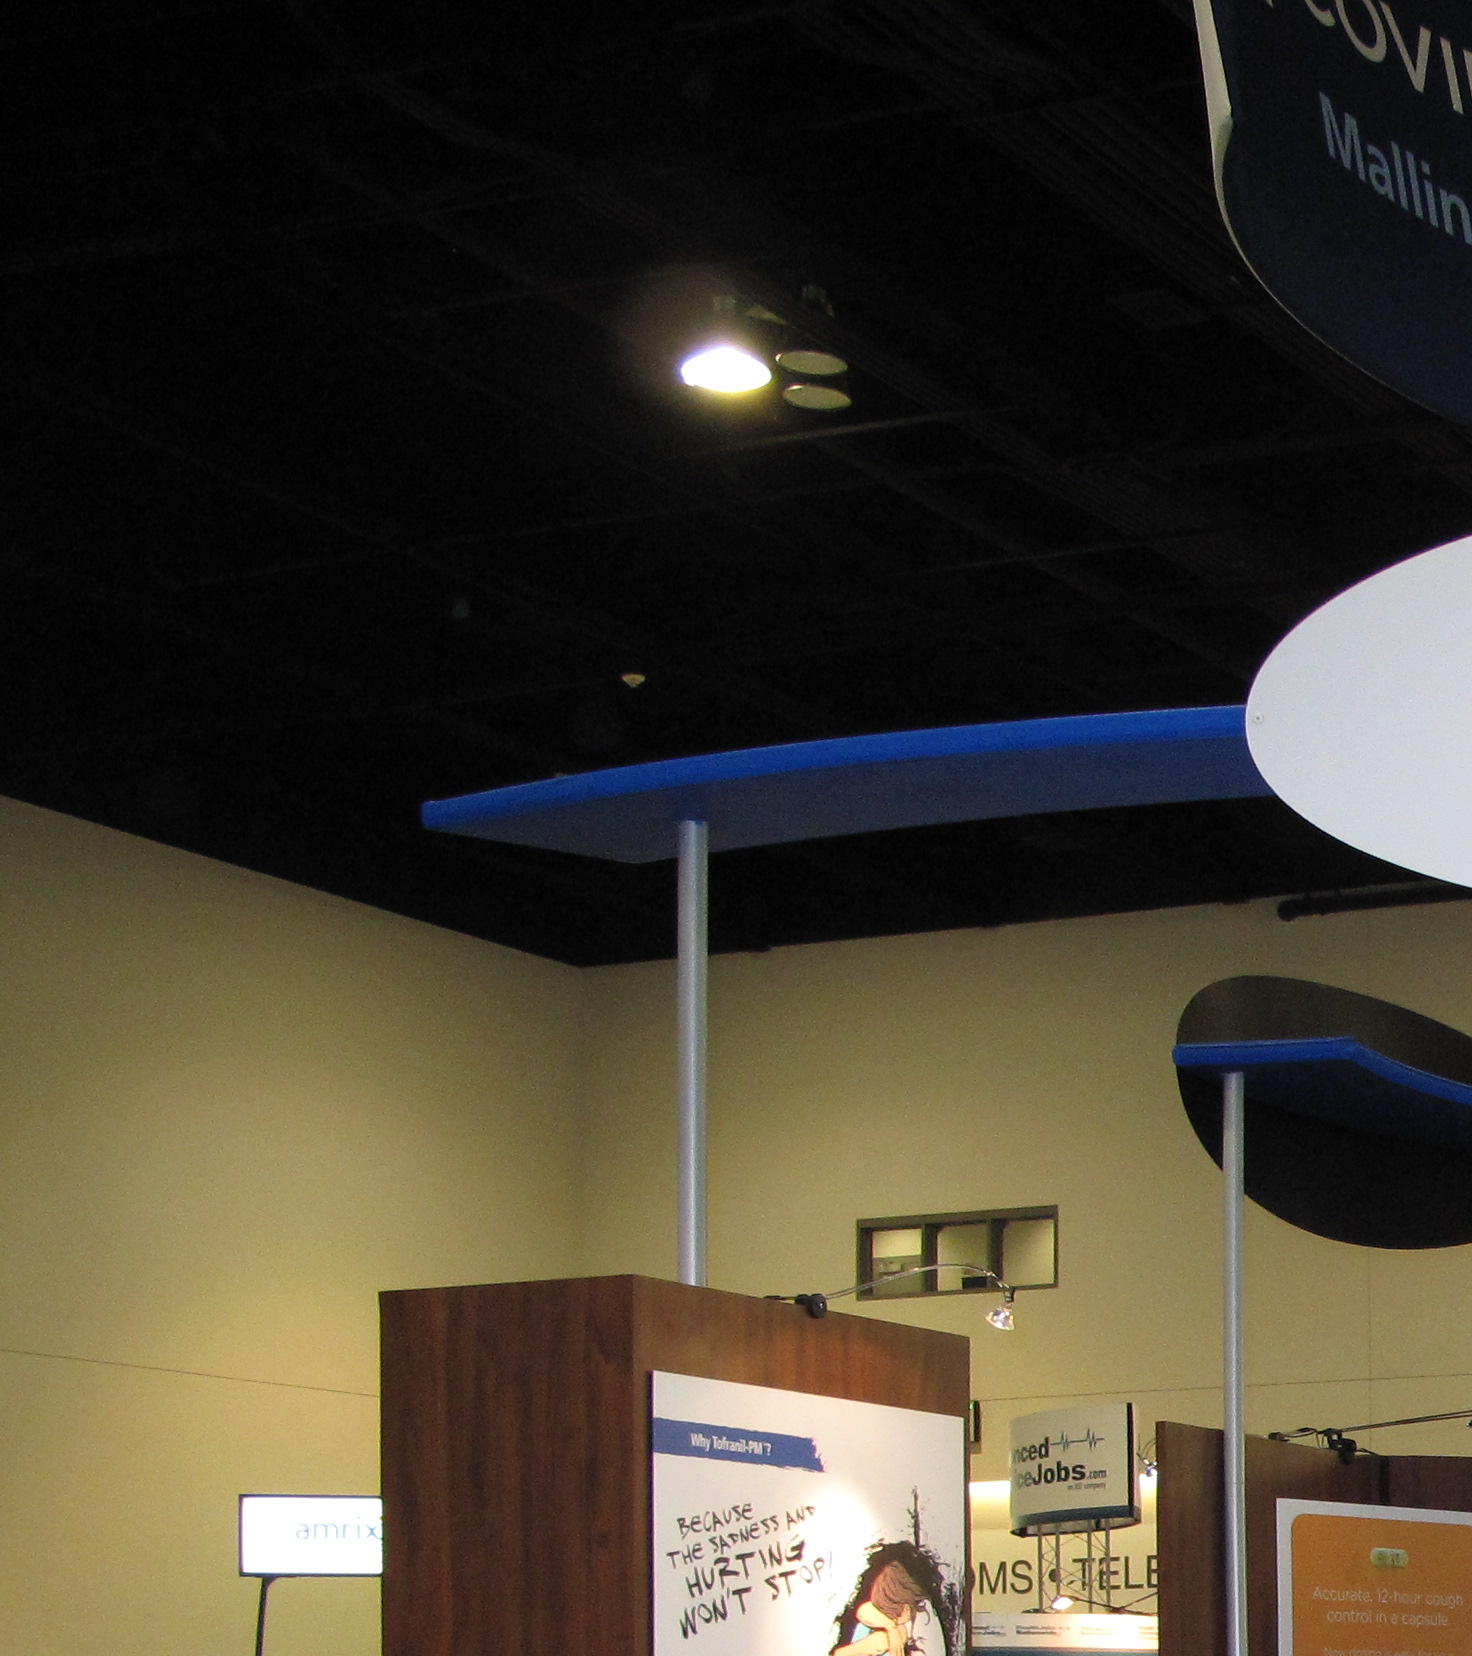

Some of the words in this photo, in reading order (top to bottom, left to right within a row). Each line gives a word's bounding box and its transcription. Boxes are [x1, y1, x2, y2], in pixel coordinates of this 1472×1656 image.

[691, 1432, 710, 1448] Why
[666, 1543, 704, 1570] THE
[708, 1515, 779, 1554] SADNESS
[785, 1505, 816, 1531] AND
[676, 1503, 754, 1540] BECAUSE
[685, 1534, 806, 1599] HURTING
[679, 1586, 753, 1640] WON'T
[764, 1551, 833, 1602] STOP!
[1426, 1595, 1463, 1609] cough
[1327, 1609, 1372, 1623] control
[1376, 1611, 1387, 1622] in
